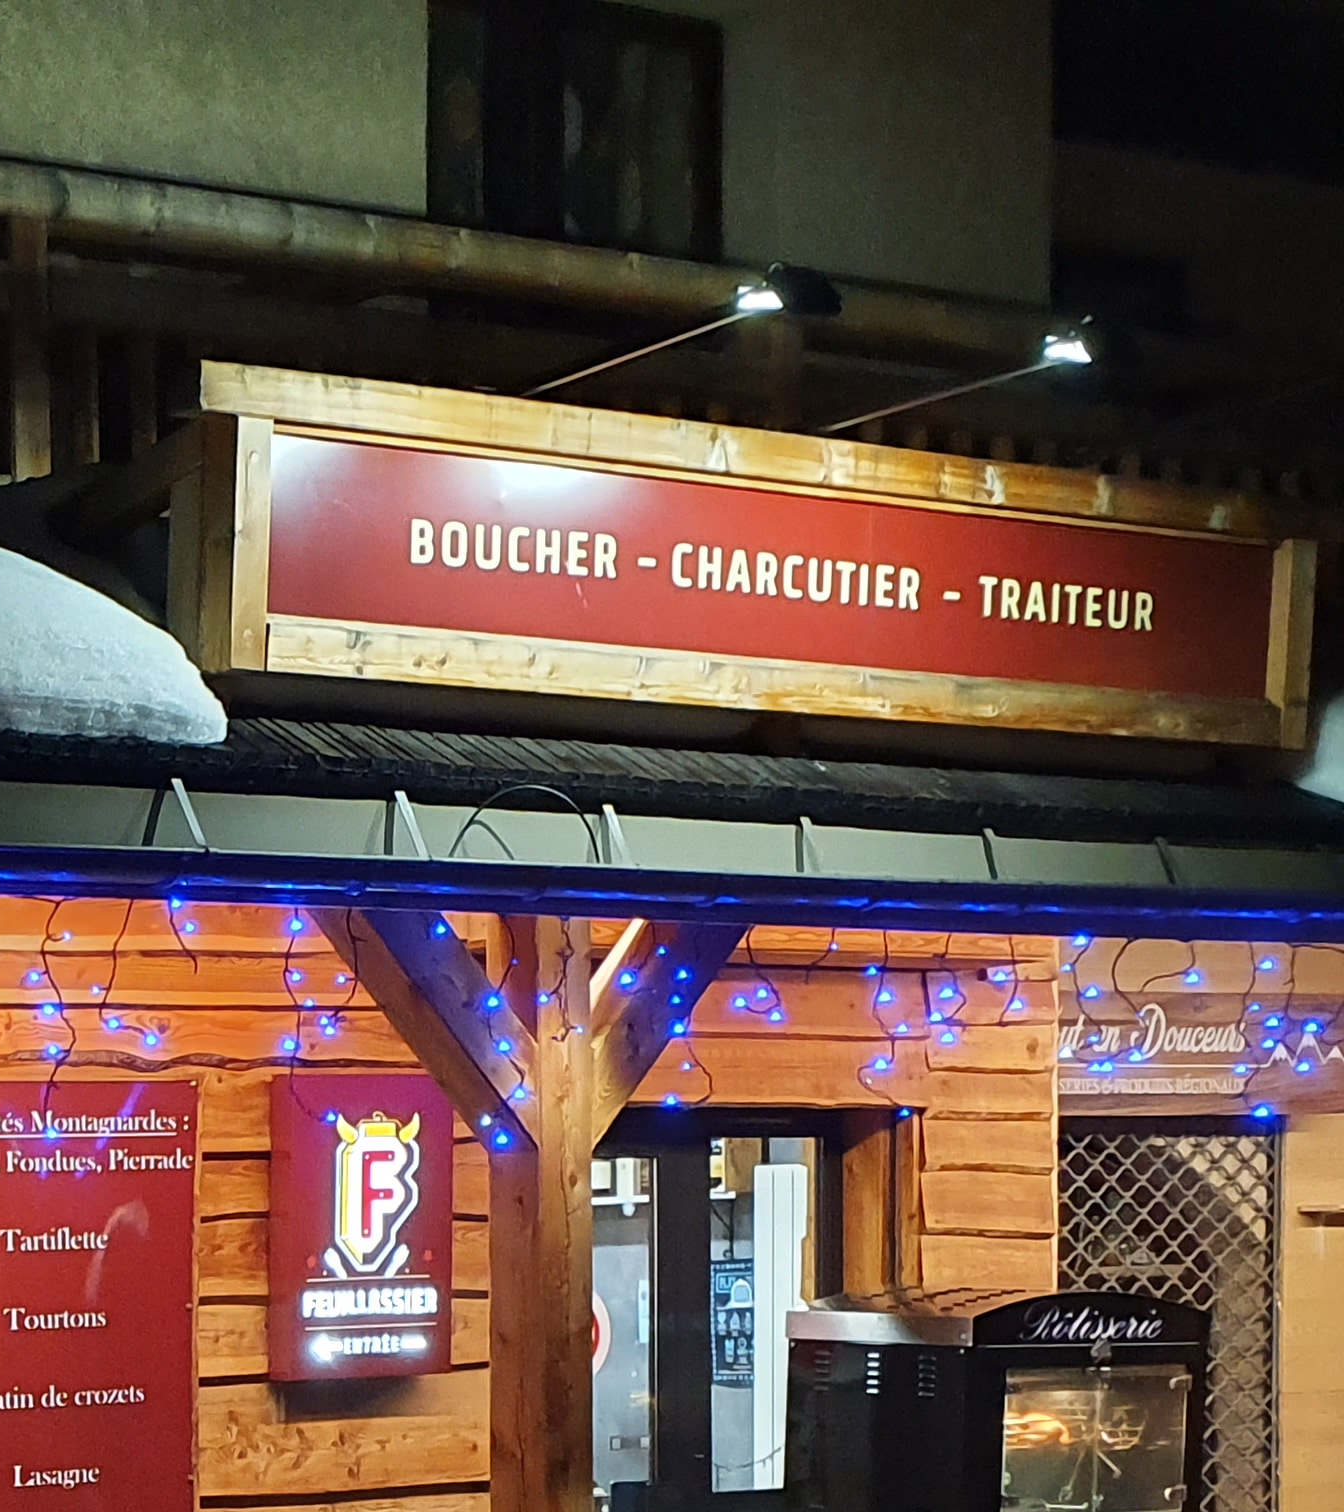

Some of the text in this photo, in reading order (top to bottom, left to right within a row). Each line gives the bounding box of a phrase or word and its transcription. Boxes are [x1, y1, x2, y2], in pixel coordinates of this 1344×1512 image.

[410, 518, 618, 580] BOUCHER
[671, 542, 921, 611] CHARCUTIER
[978, 575, 1154, 631] TRAITEUR
[31, 1108, 177, 1136] Montagnardes
[6, 1149, 103, 1174] Fondues,
[108, 1147, 195, 1172] Pierrade
[0, 1227, 110, 1252] Tartiflette
[3, 1307, 108, 1331] Tourtons
[1018, 1301, 1163, 1341] Rôtisserie
[40, 1384, 69, 1409] de
[74, 1385, 146, 1407] crozets
[13, 1464, 101, 1489] Lasagne
